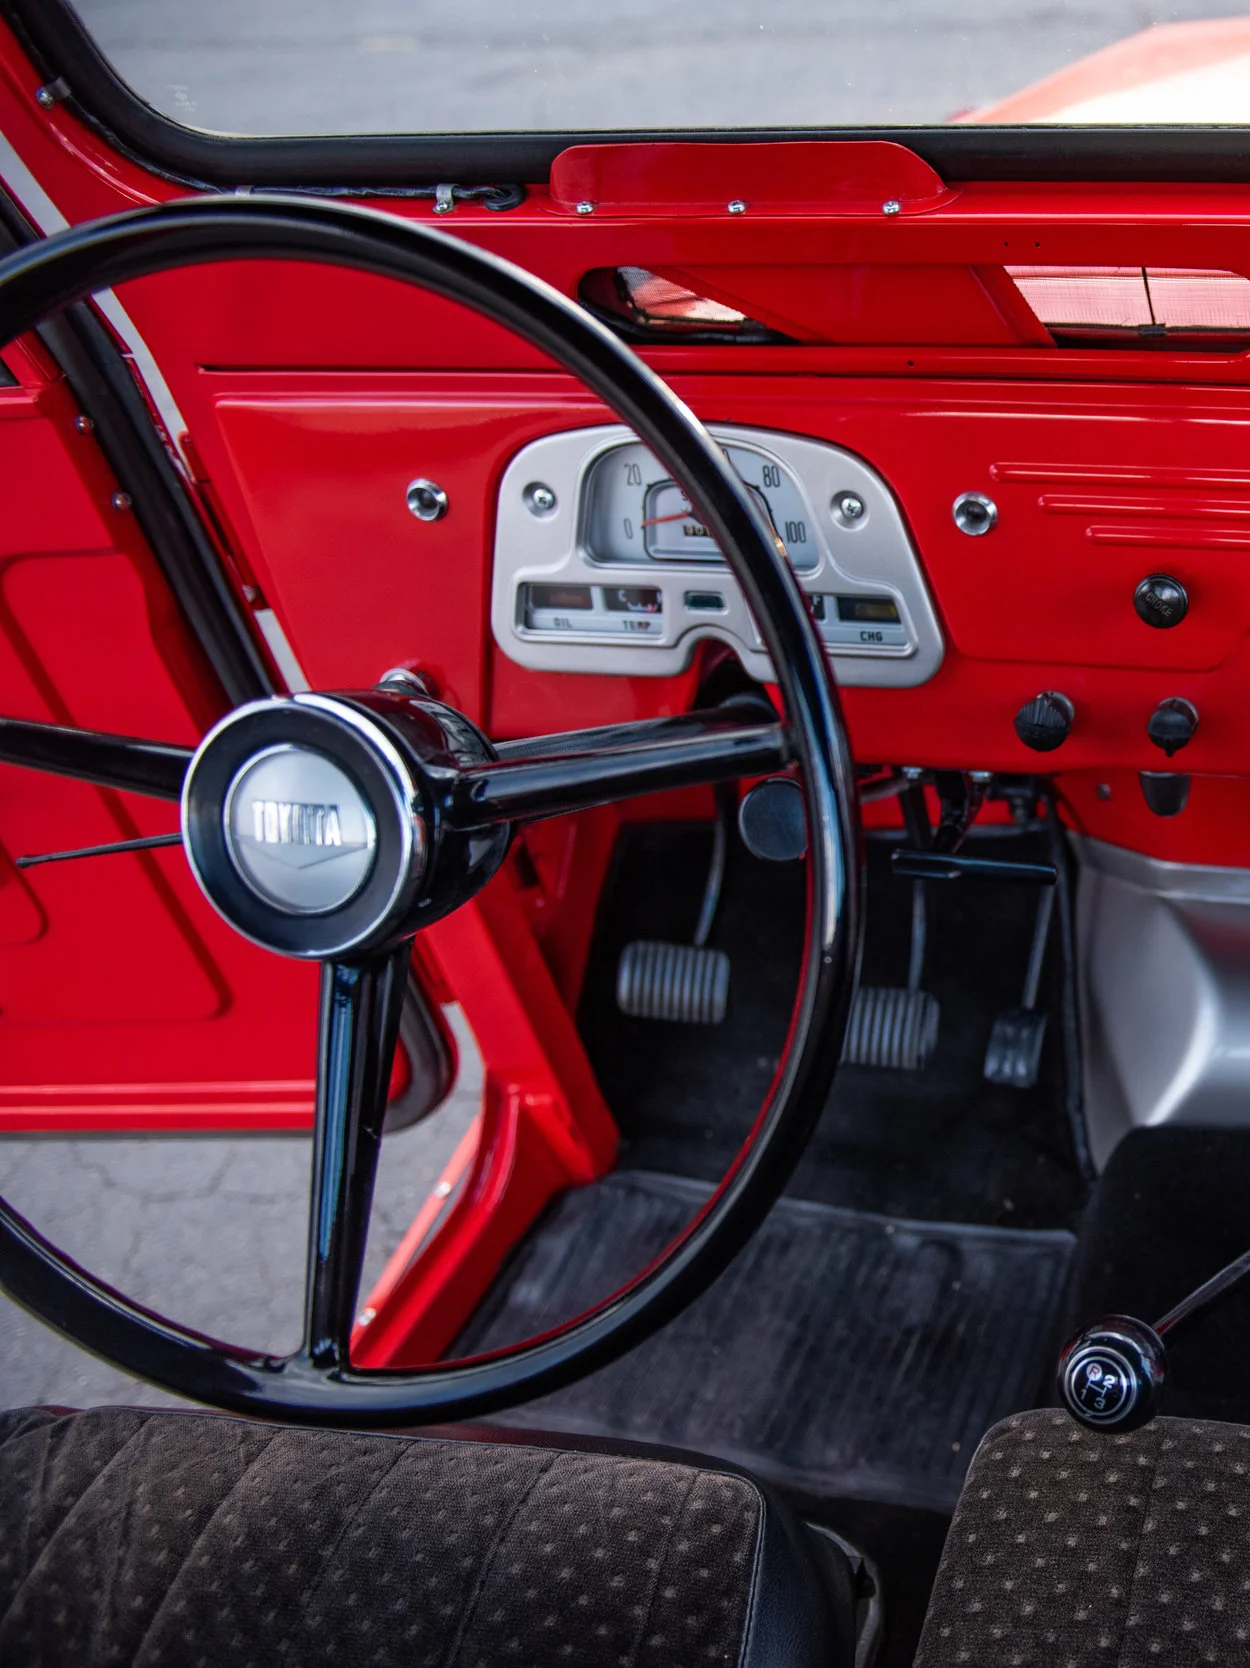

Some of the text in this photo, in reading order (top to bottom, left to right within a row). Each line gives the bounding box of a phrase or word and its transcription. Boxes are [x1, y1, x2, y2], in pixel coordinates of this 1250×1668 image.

[623, 463, 642, 486] 20
[762, 465, 781, 488] 80
[623, 518, 634, 540] 0
[785, 521, 807, 544] 100
[1145, 591, 1173, 617] CHOKE
[553, 617, 653, 632] OIL TEMP
[860, 630, 884, 642] CHG
[251, 800, 342, 847] TOYOTA
[1088, 1364, 1100, 1378] R
[1102, 1374, 1117, 1389] 2
[1093, 1396, 1106, 1410] 3
